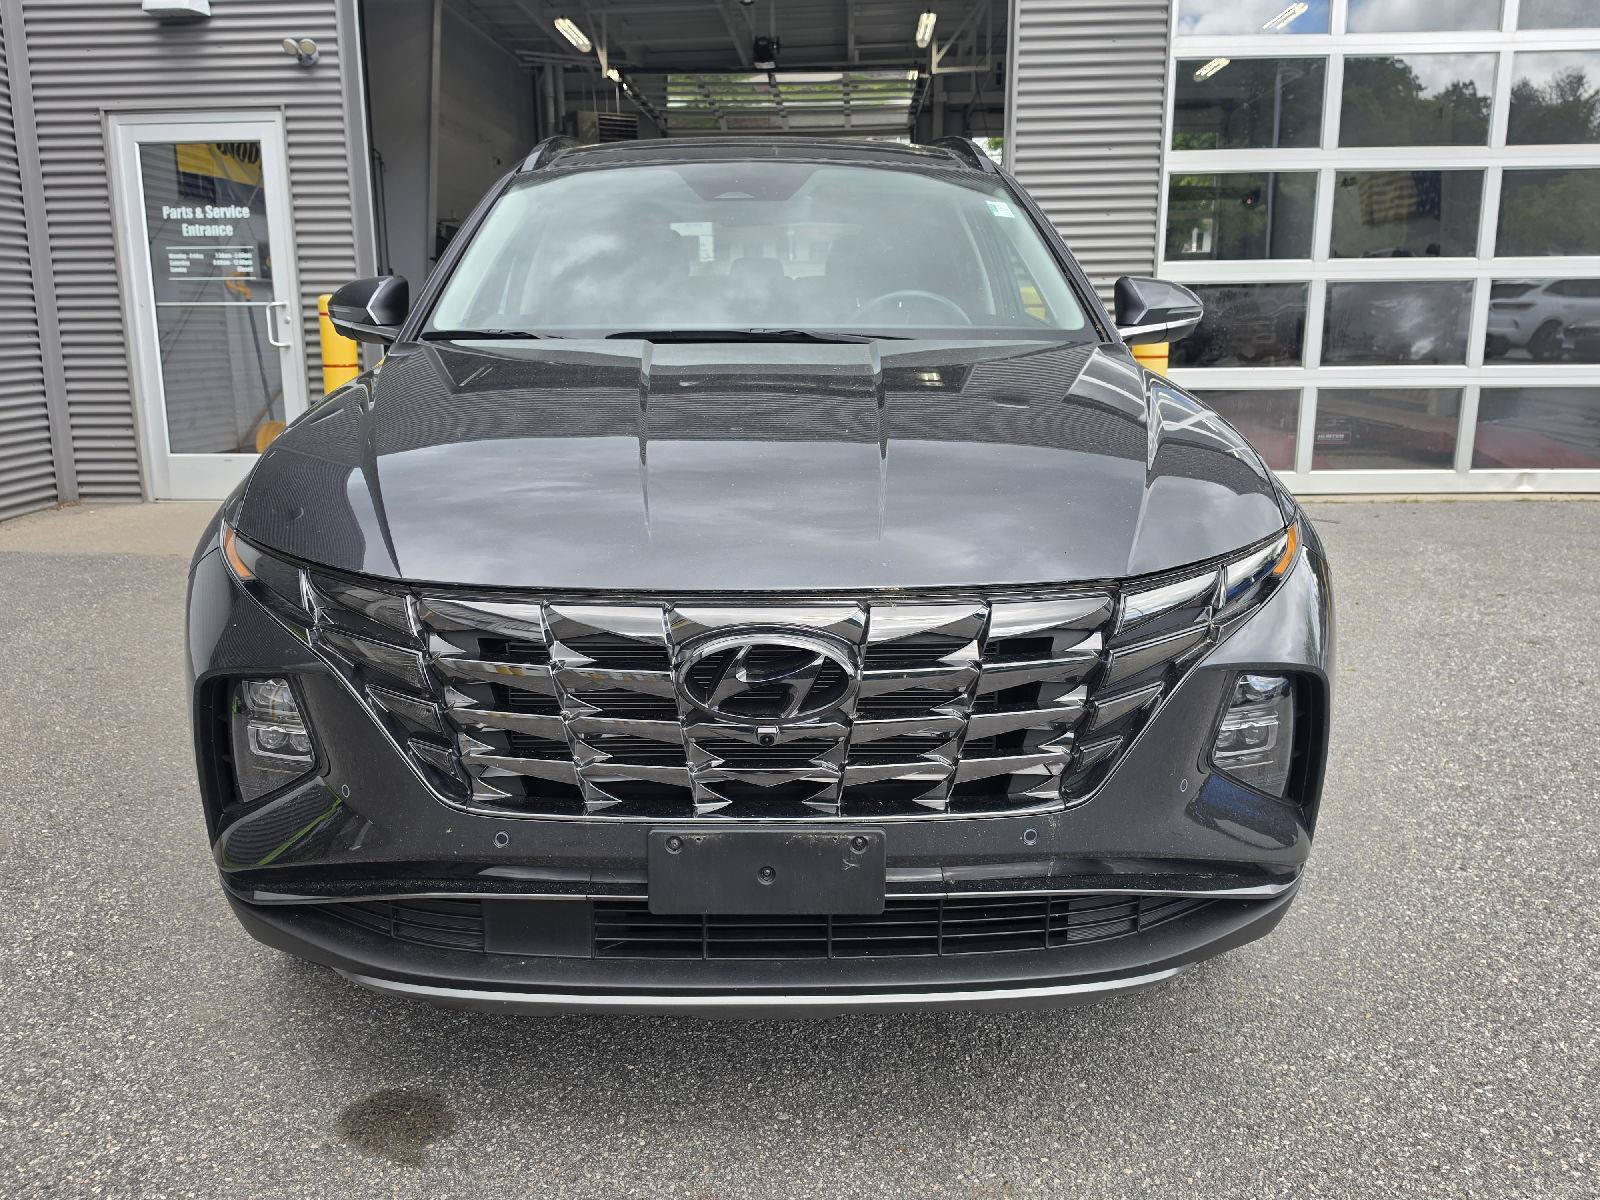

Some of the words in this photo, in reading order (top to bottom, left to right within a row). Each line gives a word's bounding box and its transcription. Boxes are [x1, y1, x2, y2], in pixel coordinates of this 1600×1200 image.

[162, 205, 194, 219] Parts
[195, 206, 204, 219] &
[205, 204, 250, 219] Service
[181, 223, 234, 237] Entrance
